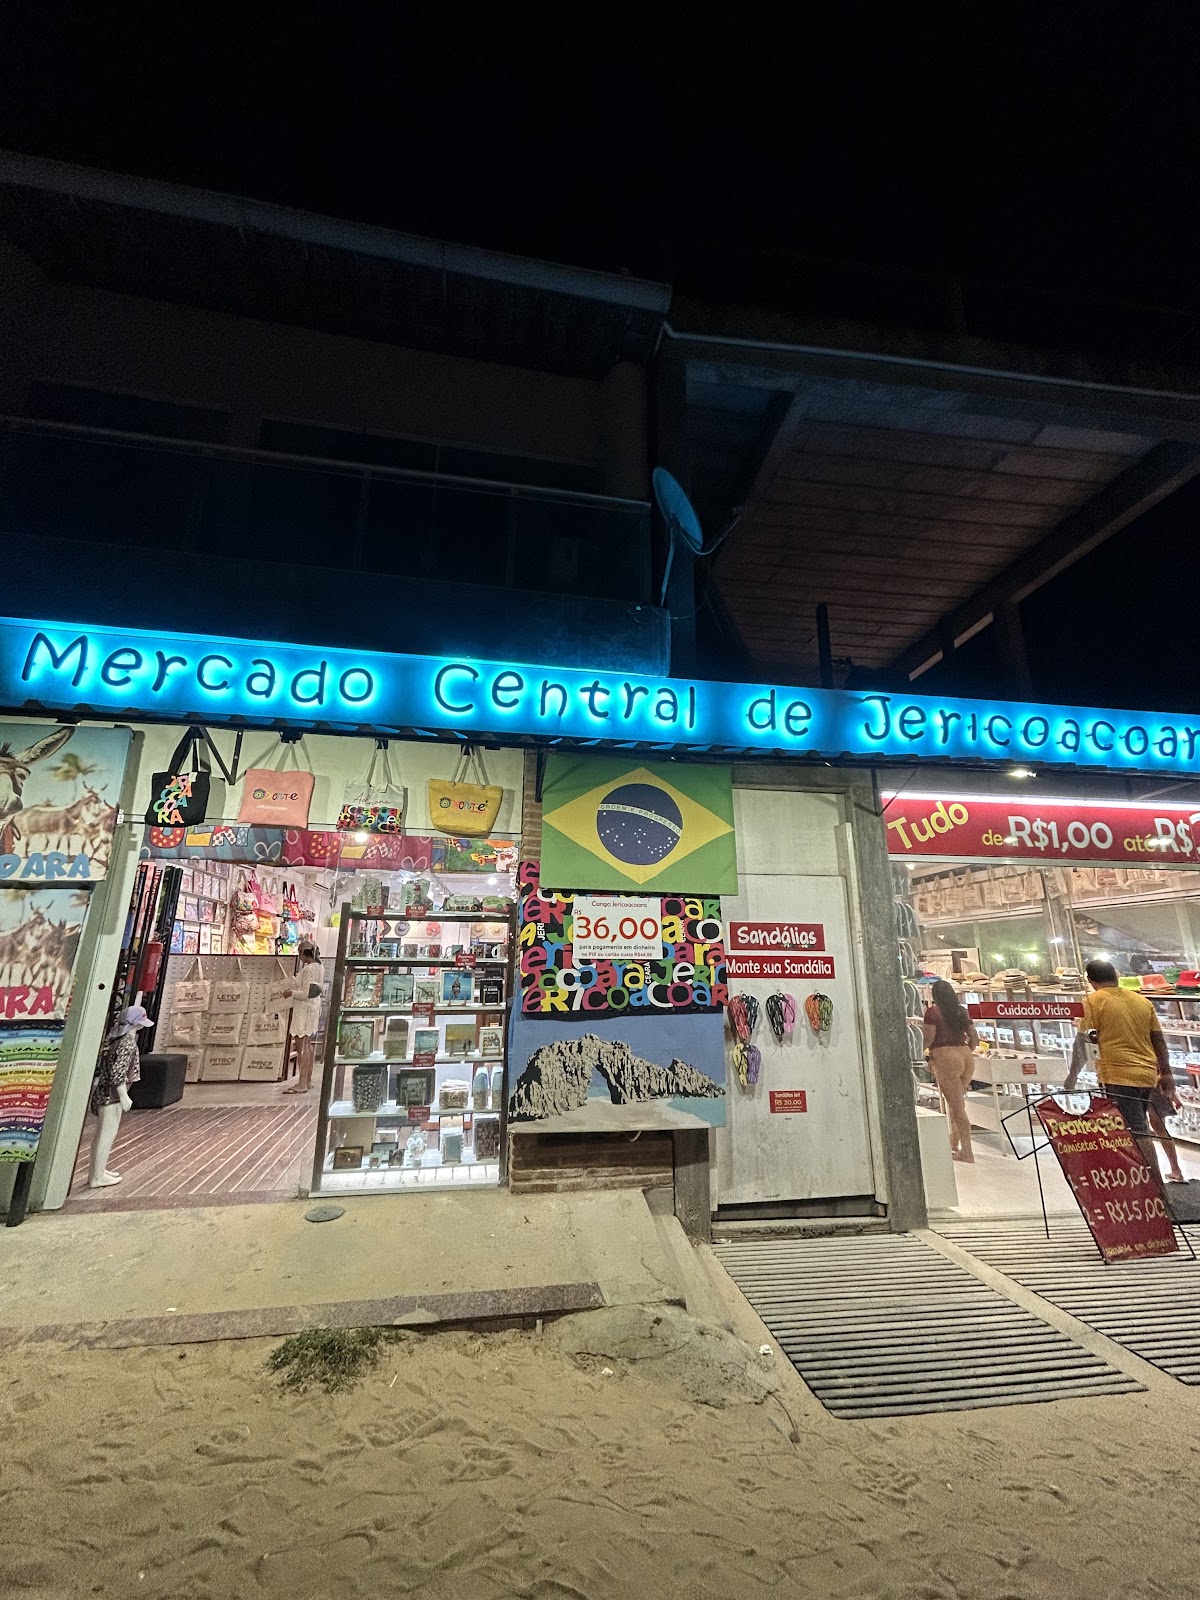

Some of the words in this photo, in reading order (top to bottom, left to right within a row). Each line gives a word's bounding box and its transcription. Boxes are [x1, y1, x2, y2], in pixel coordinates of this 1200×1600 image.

[21, 632, 374, 705] Mercado
[433, 664, 695, 729] Central
[748, 689, 812, 736] de
[638, 809, 682, 835] PROGRESSO
[887, 801, 969, 850] Tudo
[982, 829, 1003, 846] de
[1007, 815, 1114, 853] R$1,00
[576, 916, 659, 943] 36,00
[736, 926, 817, 946] Sandálias
[725, 958, 761, 974] Monte
[762, 963, 782, 974] sua
[784, 959, 832, 975] Sandália
[0, 985, 56, 1019] RA
[996, 1003, 1041, 1016] Cuidado
[1042, 1003, 1071, 1016] Vidro
[1046, 1112, 1126, 1138] Promoção
[1057, 1139, 1098, 1155] Camisetas
[1099, 1136, 1134, 1153] Regatas
[1090, 1165, 1152, 1191] R$10,00
[1105, 1197, 1167, 1226] R$15,00
